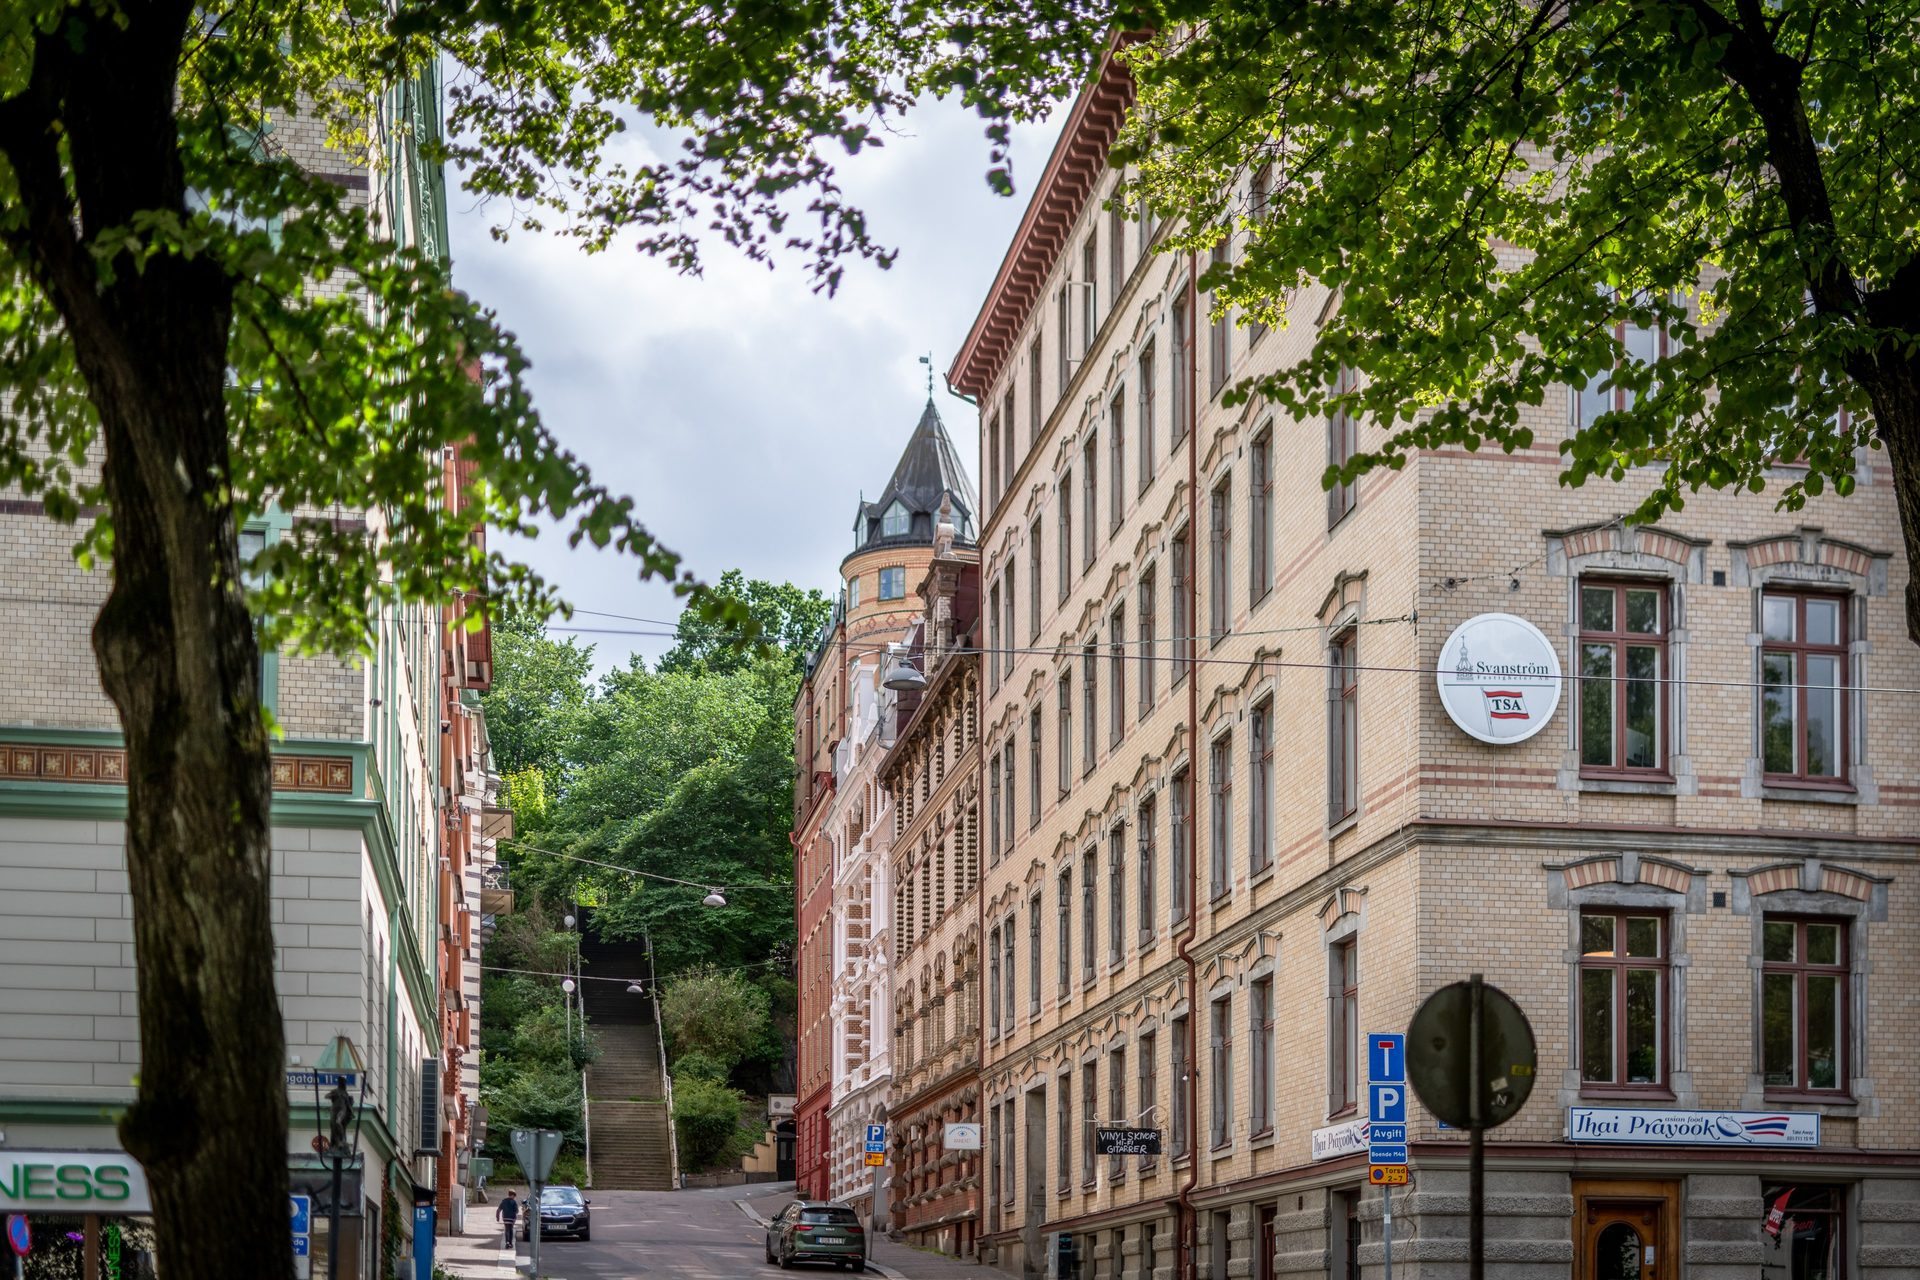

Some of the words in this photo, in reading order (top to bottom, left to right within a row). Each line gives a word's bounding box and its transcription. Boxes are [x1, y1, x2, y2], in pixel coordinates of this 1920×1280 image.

[1477, 661, 1549, 675] Svanström
[1492, 698, 1522, 711] TSA
[1378, 1088, 1399, 1119] P
[1574, 1111, 1619, 1137] Thai
[1628, 1116, 1721, 1140] Prayook
[871, 1126, 881, 1141] P
[1373, 1129, 1402, 1139] Avgift
[1106, 1144, 1148, 1154] GITARRER
